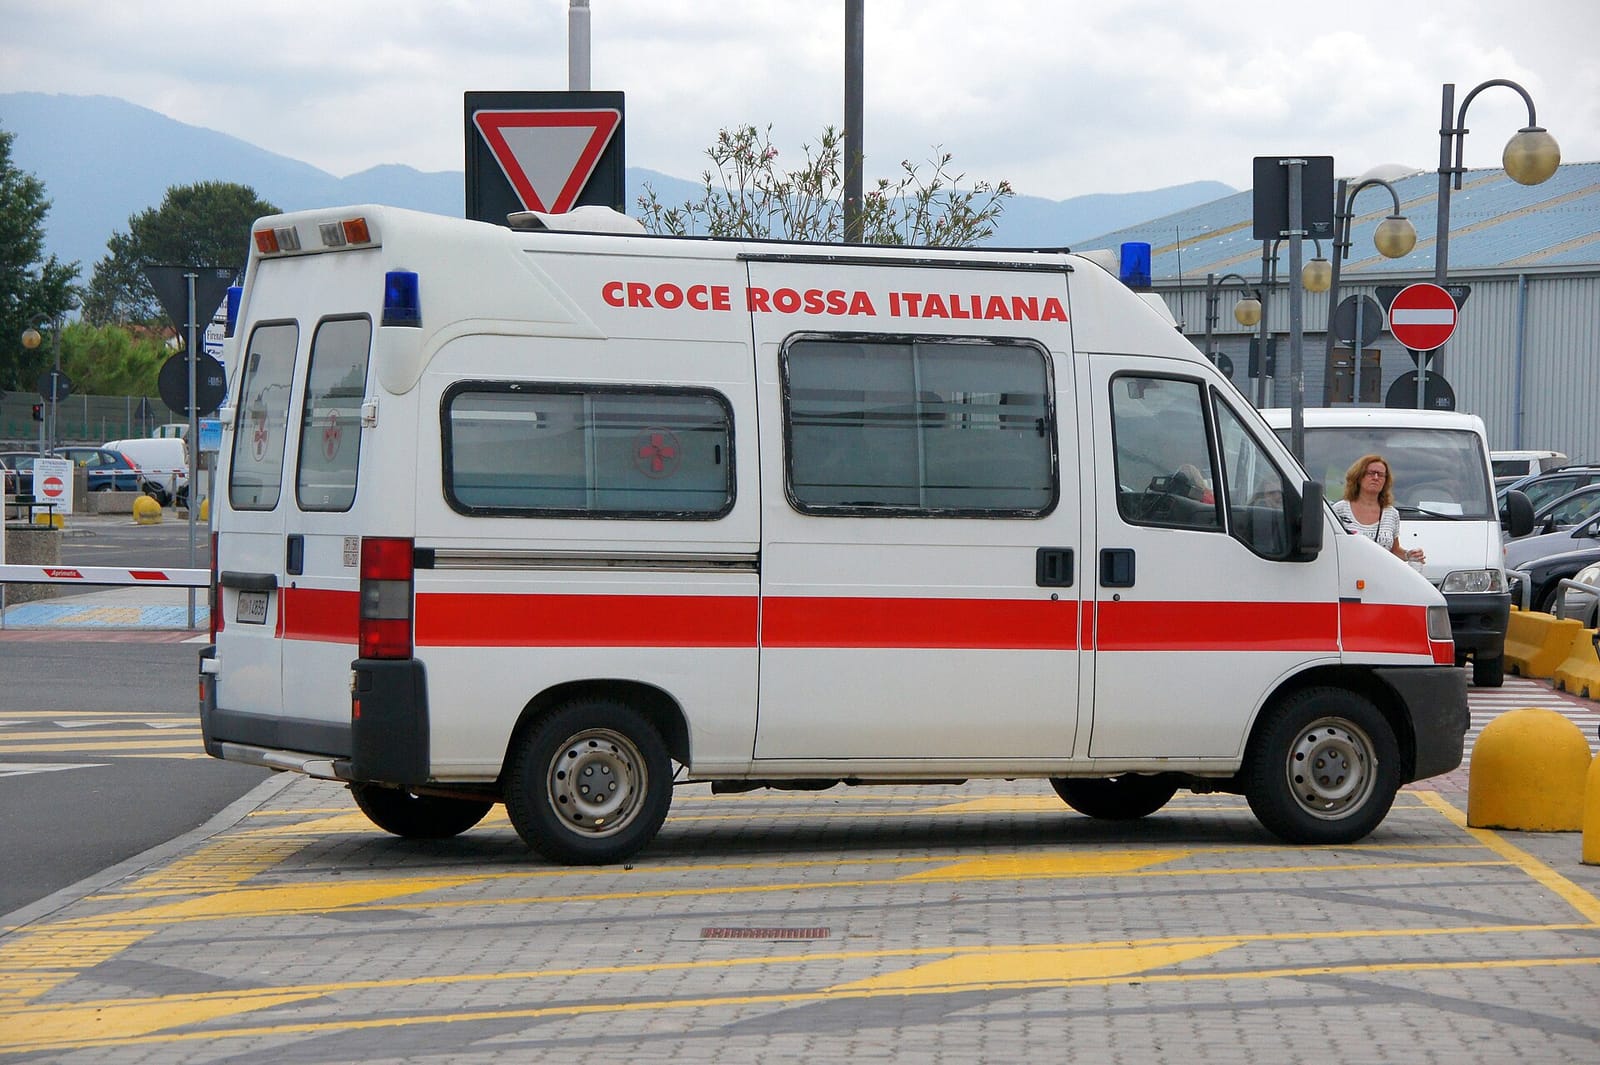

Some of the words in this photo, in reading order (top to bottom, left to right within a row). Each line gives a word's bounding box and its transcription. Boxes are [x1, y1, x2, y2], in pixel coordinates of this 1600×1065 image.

[602, 281, 731, 311] CROCE
[746, 287, 877, 316] ROSSA
[889, 292, 1069, 322] ITALIANA
